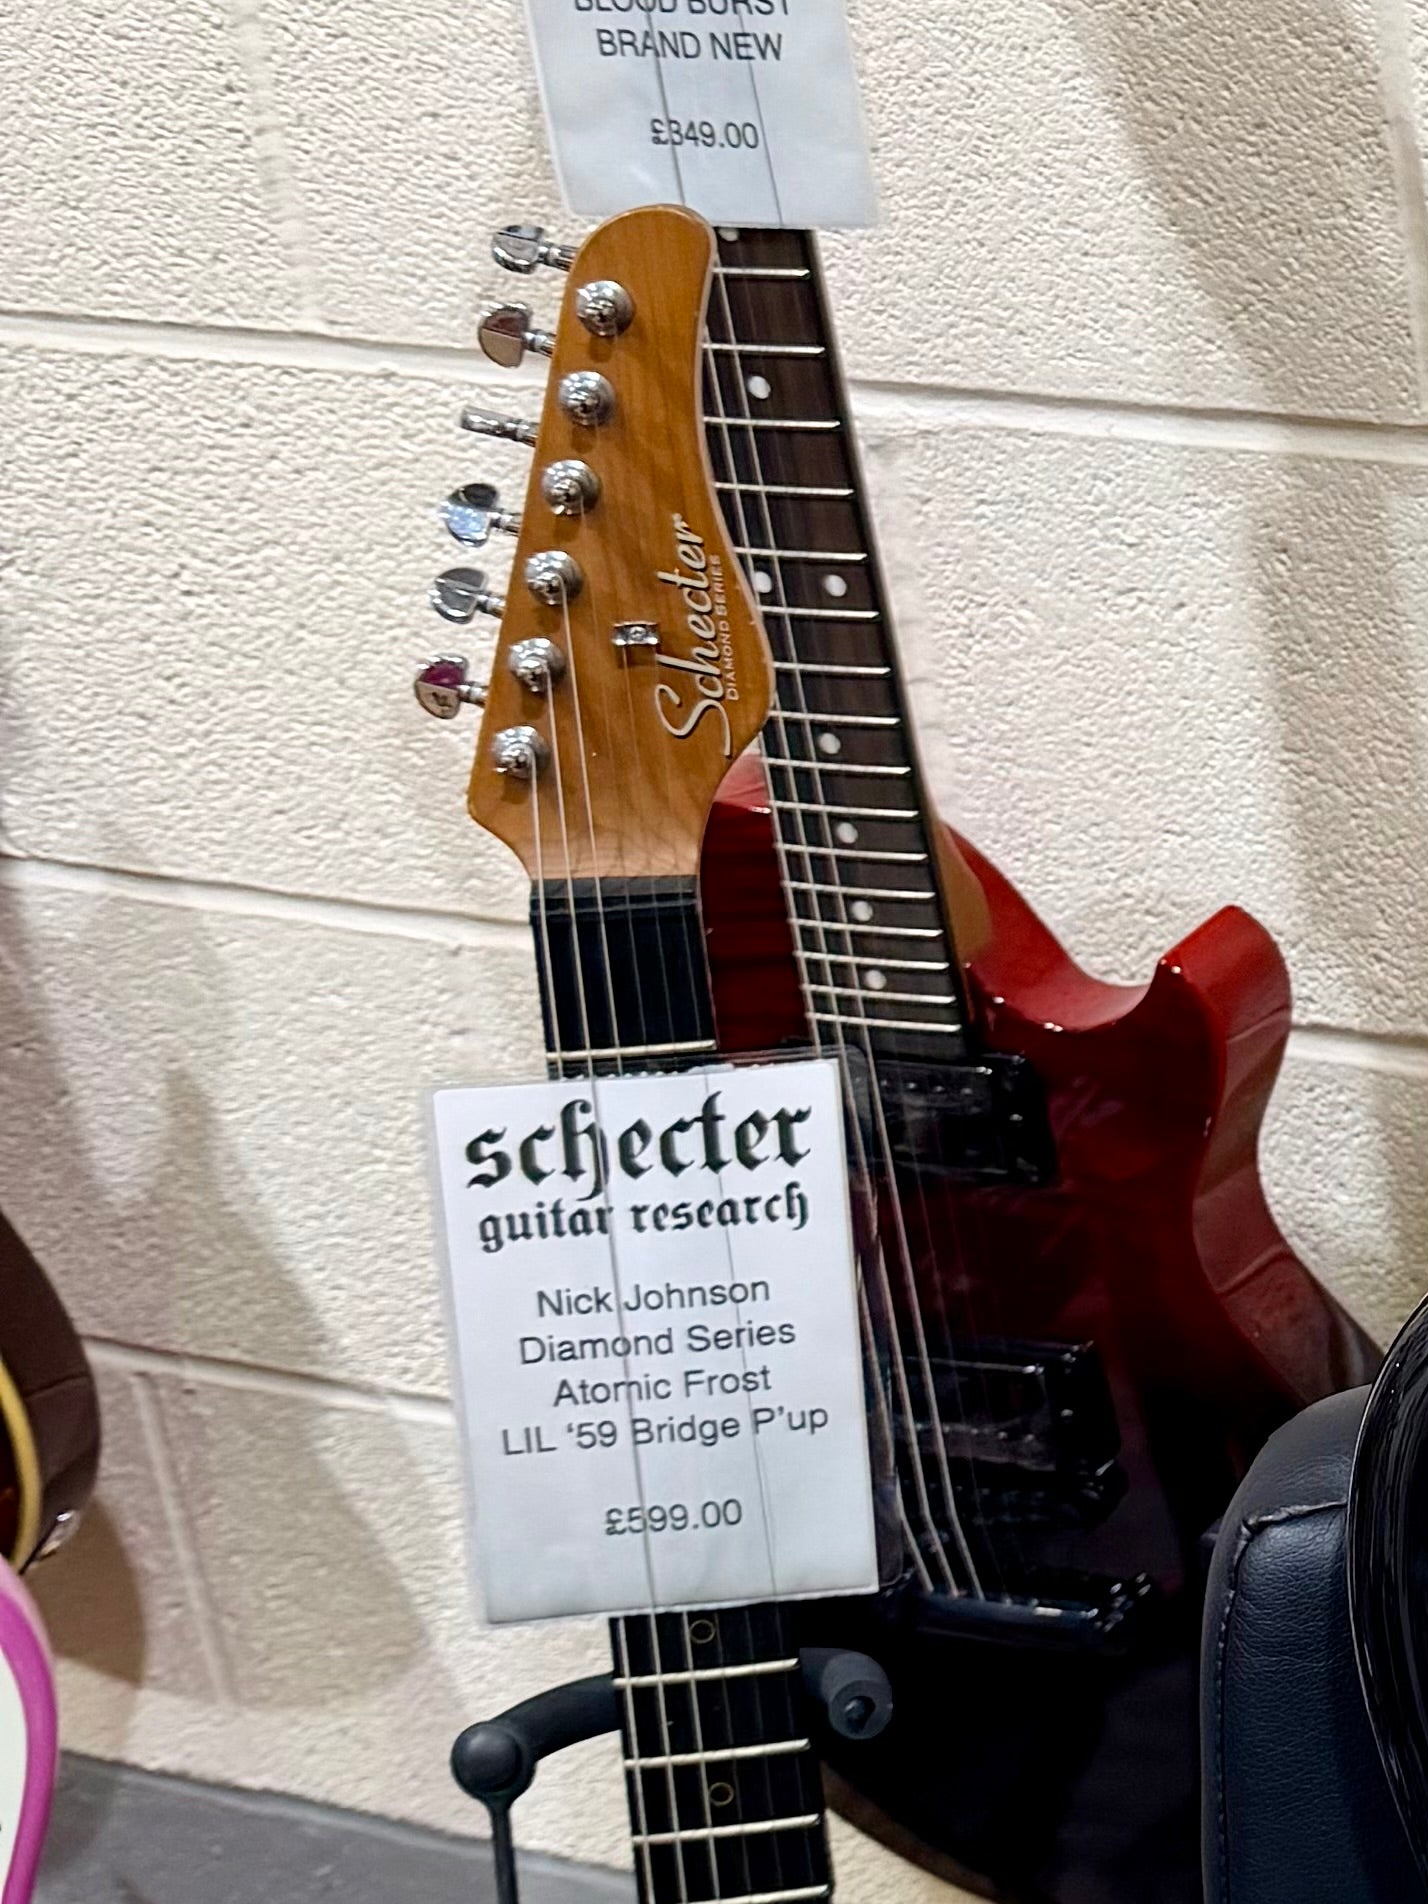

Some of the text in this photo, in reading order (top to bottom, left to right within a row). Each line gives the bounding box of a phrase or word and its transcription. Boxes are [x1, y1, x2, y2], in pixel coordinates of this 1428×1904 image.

[595, 27, 783, 61] BRAND NEW
[709, 553, 740, 701] DIAMOND SERIES
[464, 1090, 813, 1201] schecter
[478, 1181, 810, 1254] guitar research
[535, 1278, 771, 1318] Nick Johnson
[518, 1319, 797, 1365] Diamond Series
[552, 1363, 773, 1408] Atomic Frost
[501, 1424, 558, 1456] LIL
[630, 1414, 741, 1447] Bridge
[604, 1497, 744, 1536] £599.00
